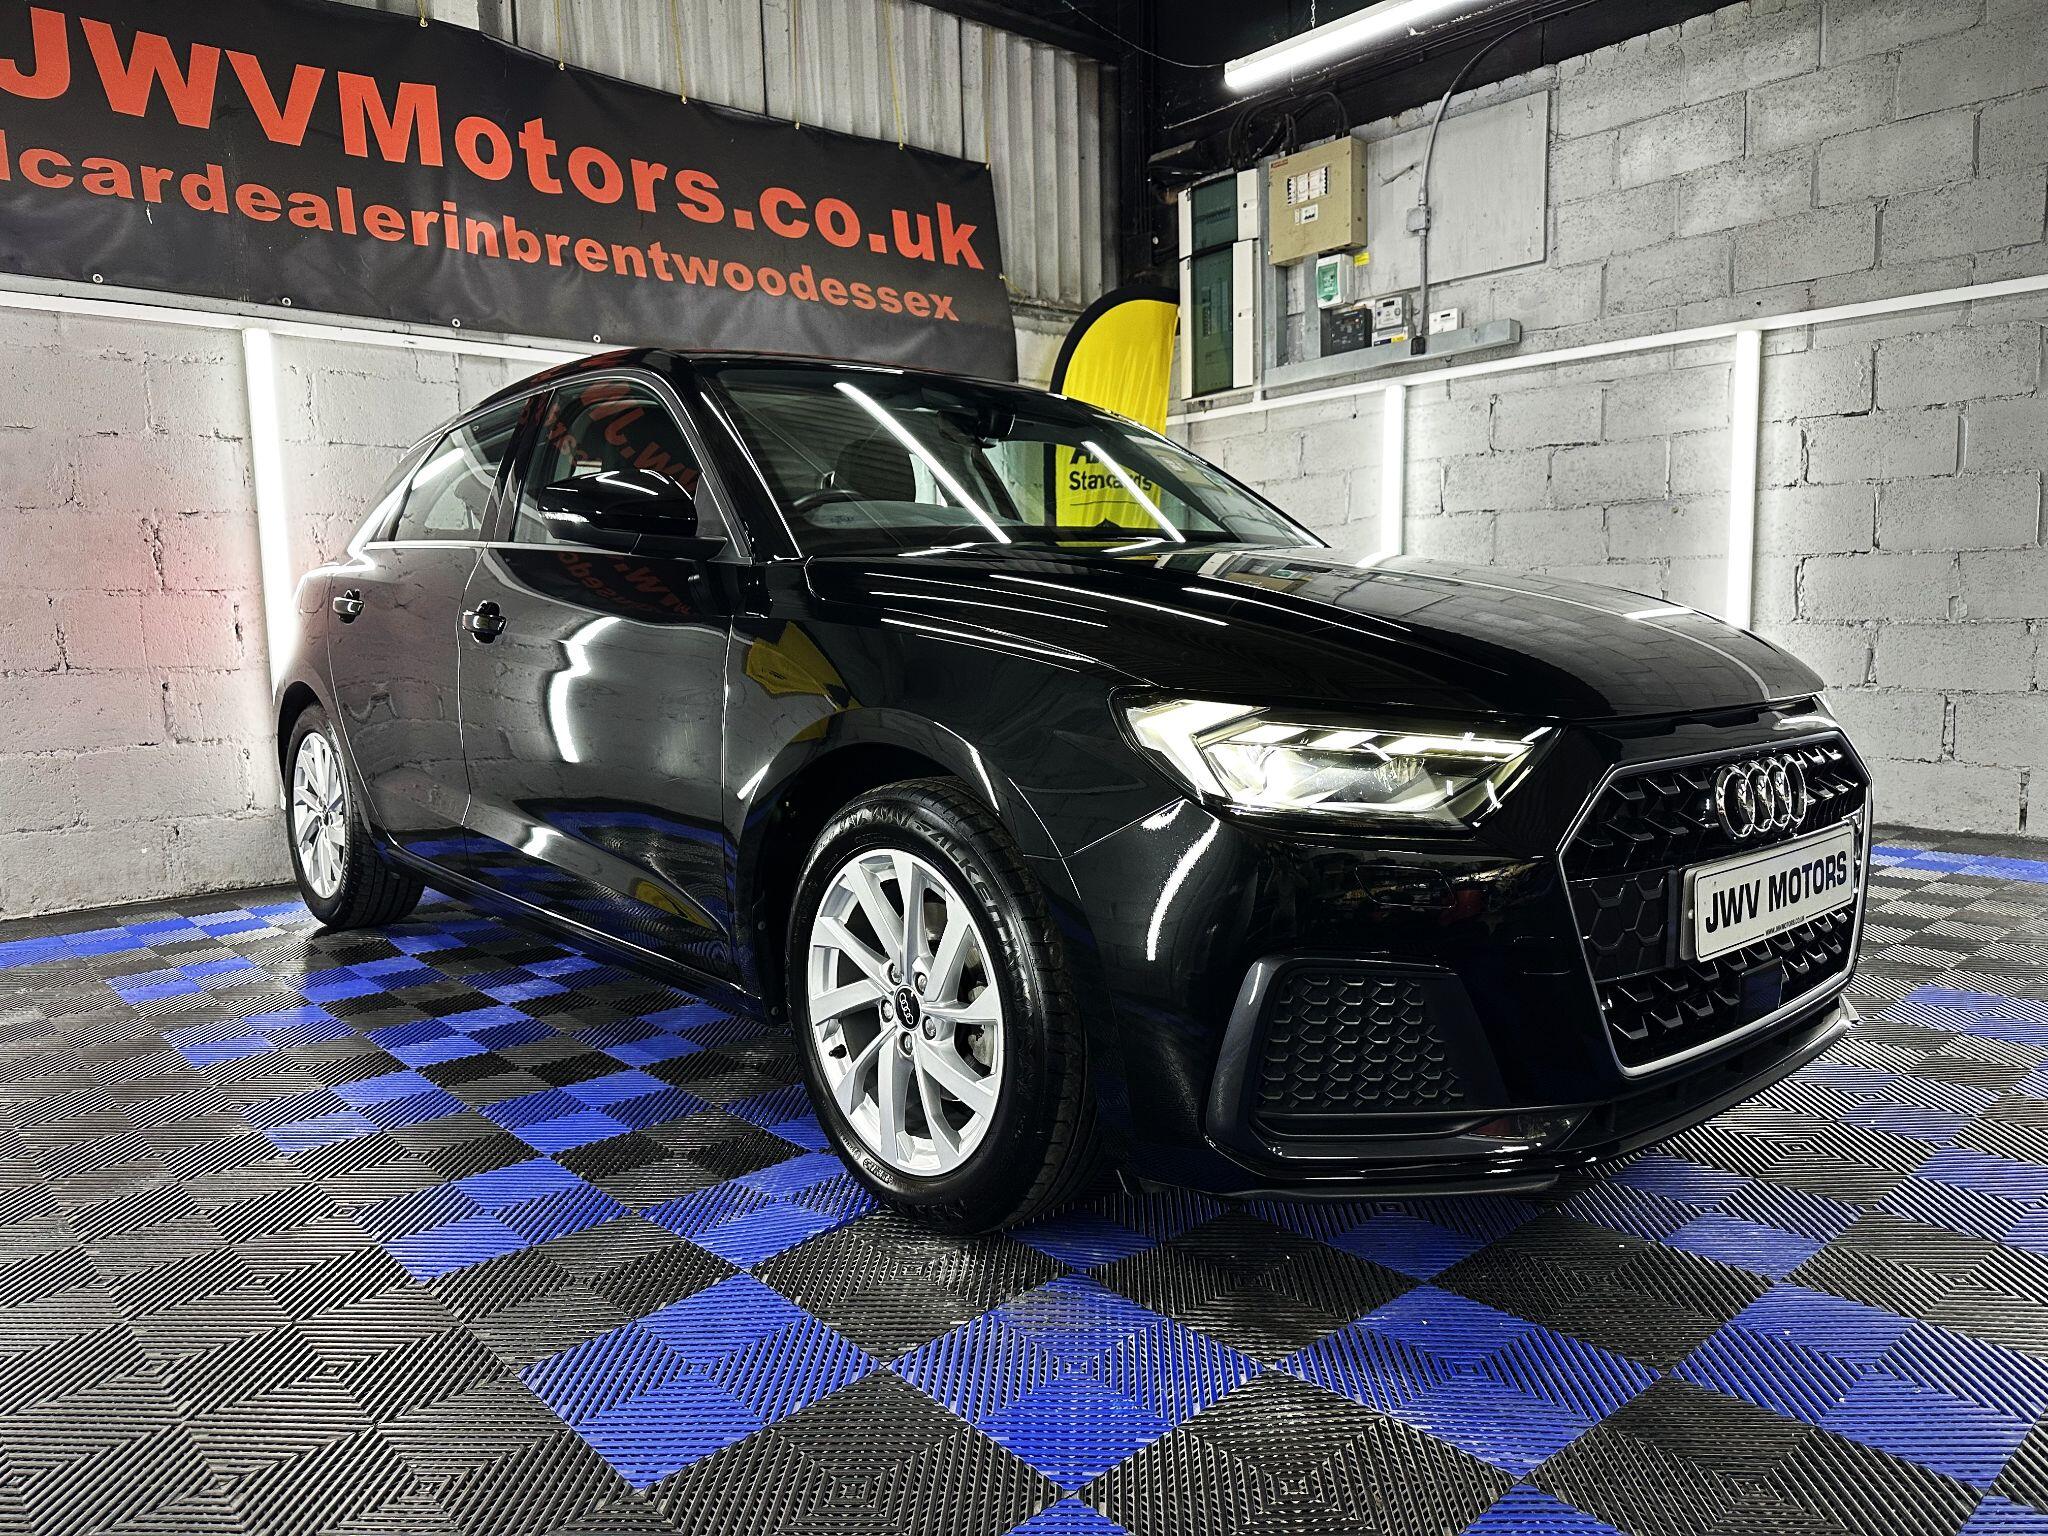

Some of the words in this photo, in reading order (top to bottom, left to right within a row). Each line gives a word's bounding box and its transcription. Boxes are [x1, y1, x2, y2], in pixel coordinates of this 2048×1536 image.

[0, 7, 983, 270] JWVMotors.co.uk
[1705, 879, 1761, 934] JWV
[1768, 850, 1847, 913] MOTORS
